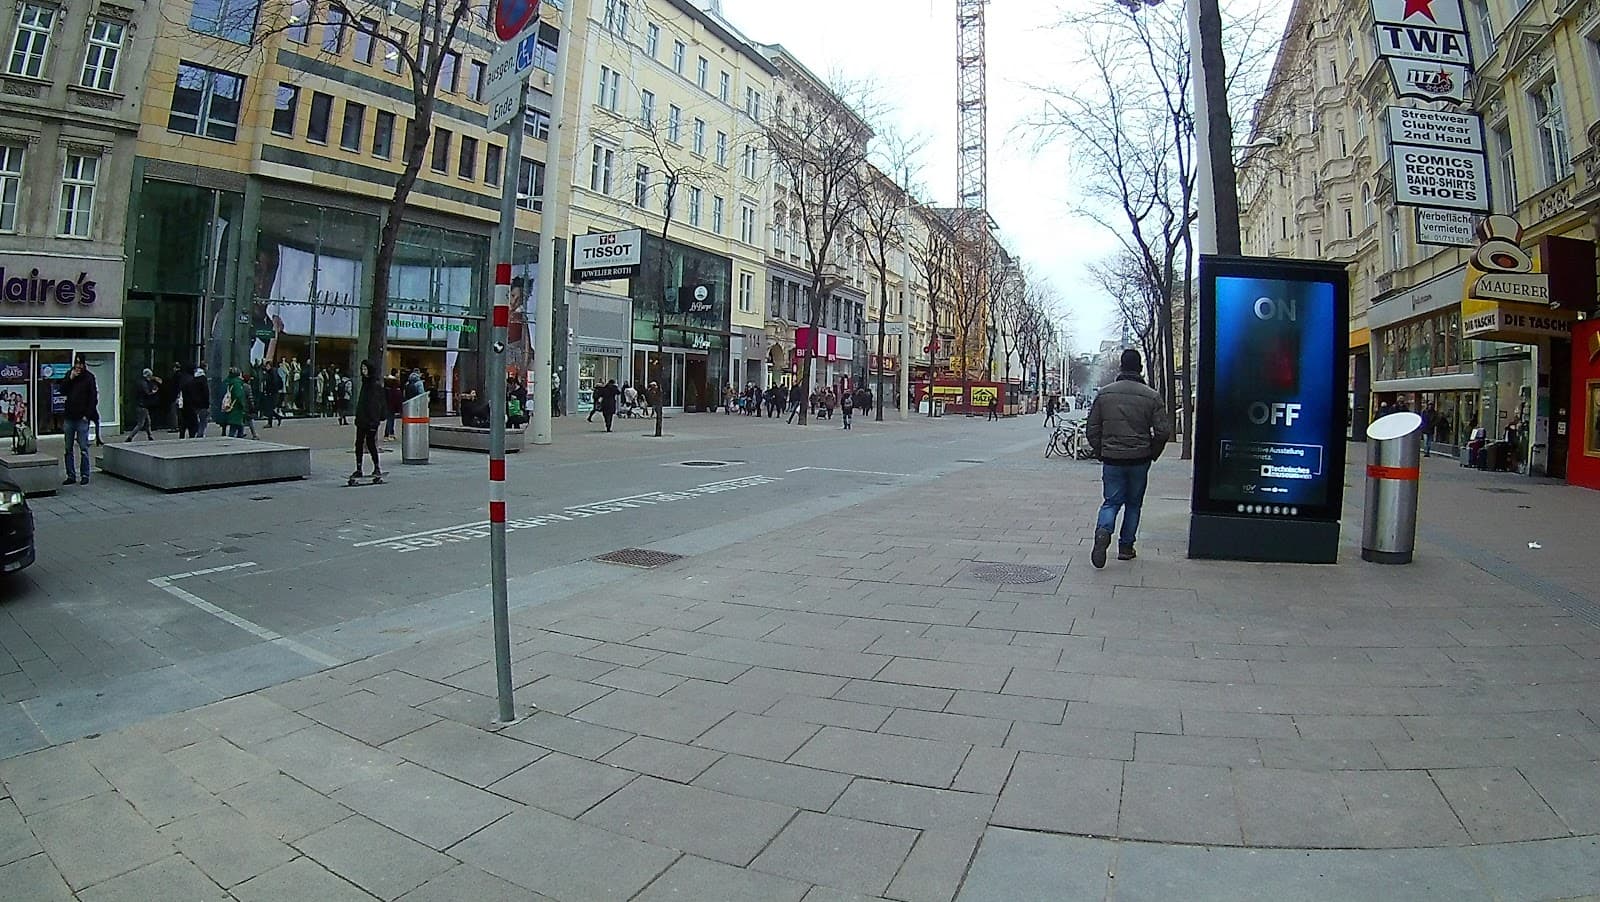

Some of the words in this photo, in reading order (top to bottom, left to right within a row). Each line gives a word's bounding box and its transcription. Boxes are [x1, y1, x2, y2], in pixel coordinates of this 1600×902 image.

[1382, 27, 1463, 57] TWA
[493, 96, 513, 121] Ende
[1401, 110, 1469, 124] Streetwear
[1402, 120, 1470, 134] Clubwear
[1403, 130, 1430, 140] 2nd
[1435, 132, 1471, 145] Hand
[1405, 153, 1473, 169] COMICS
[1405, 164, 1475, 180] RECORDS
[1407, 174, 1476, 191] BAND-SHIRTS
[1408, 185, 1477, 201] SHOES
[1423, 223, 1468, 235] vermieten
[583, 244, 632, 259] TISSOT
[581, 269, 612, 278] JUWELIER
[613, 267, 632, 276] ROTH
[1480, 279, 1548, 299] MAUERER
[1254, 297, 1297, 321] ON
[1464, 319, 1473, 331] DIE
[1473, 314, 1496, 329] TASCHE
[1504, 314, 1525, 327] DIE
[0, 369, 23, 377] GRATIS
[1248, 401, 1302, 426] OFF
[1270, 447, 1305, 457] Ausstellung
